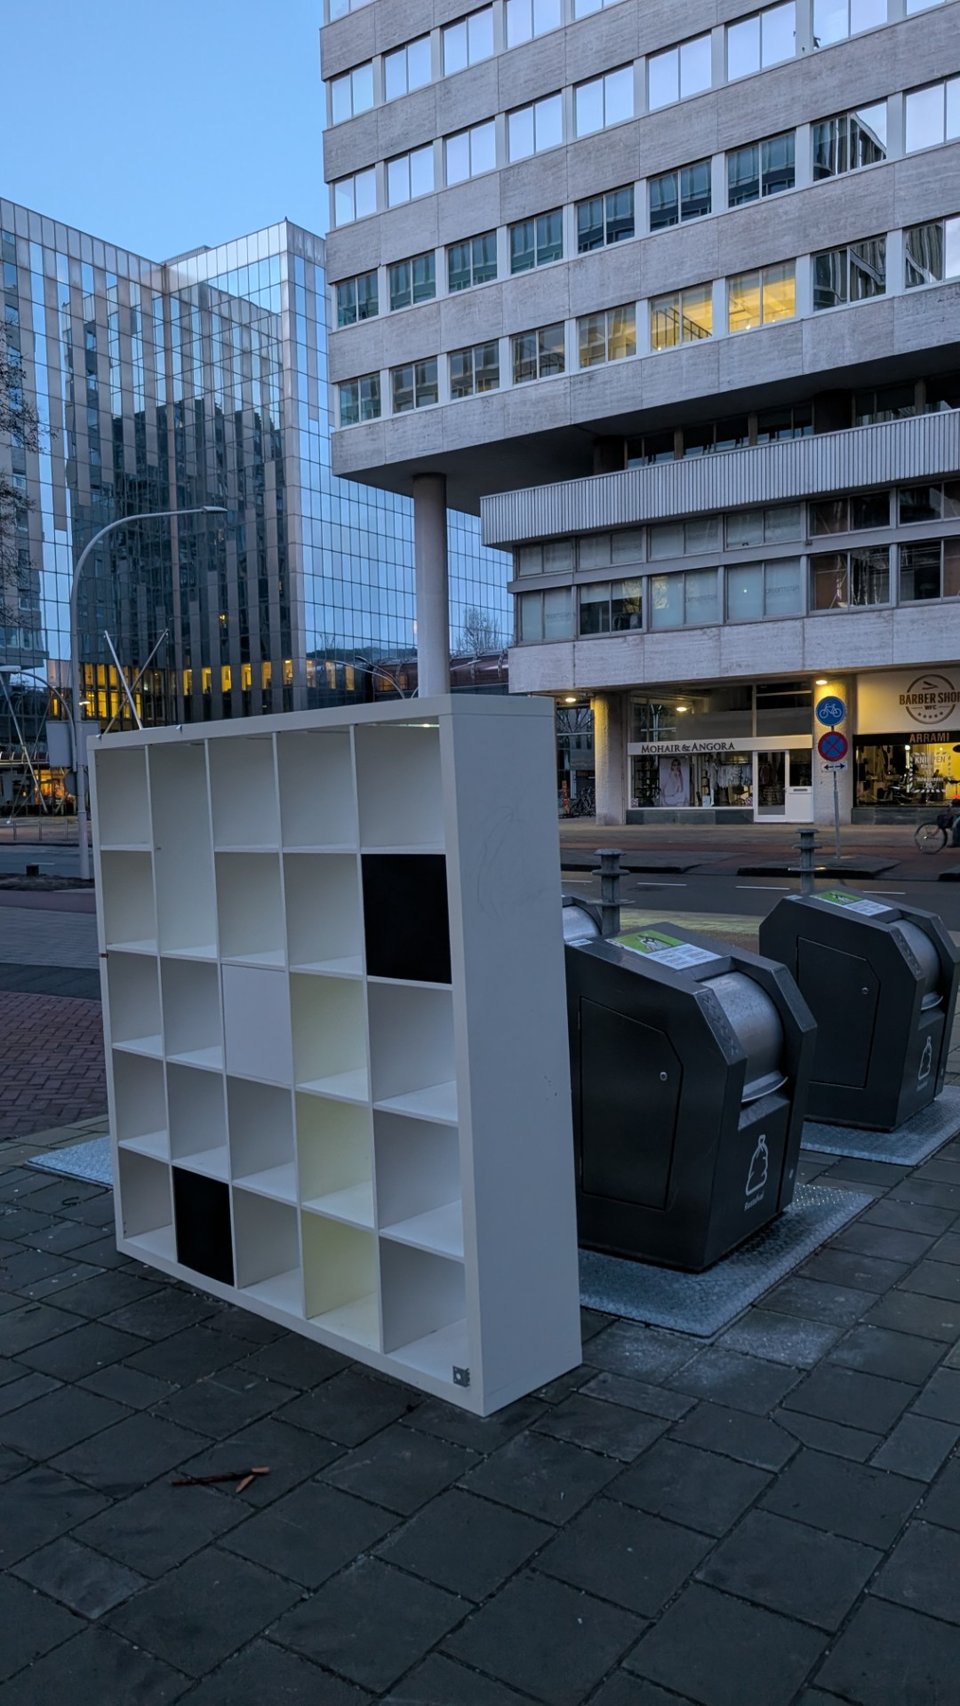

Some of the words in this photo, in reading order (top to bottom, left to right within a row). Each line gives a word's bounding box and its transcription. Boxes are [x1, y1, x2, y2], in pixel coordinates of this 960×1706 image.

[899, 693, 936, 705] BARBER
[909, 732, 950, 743] ARRAMI
[641, 744, 680, 754] MOHAIR
[691, 741, 735, 752] ANGORA
